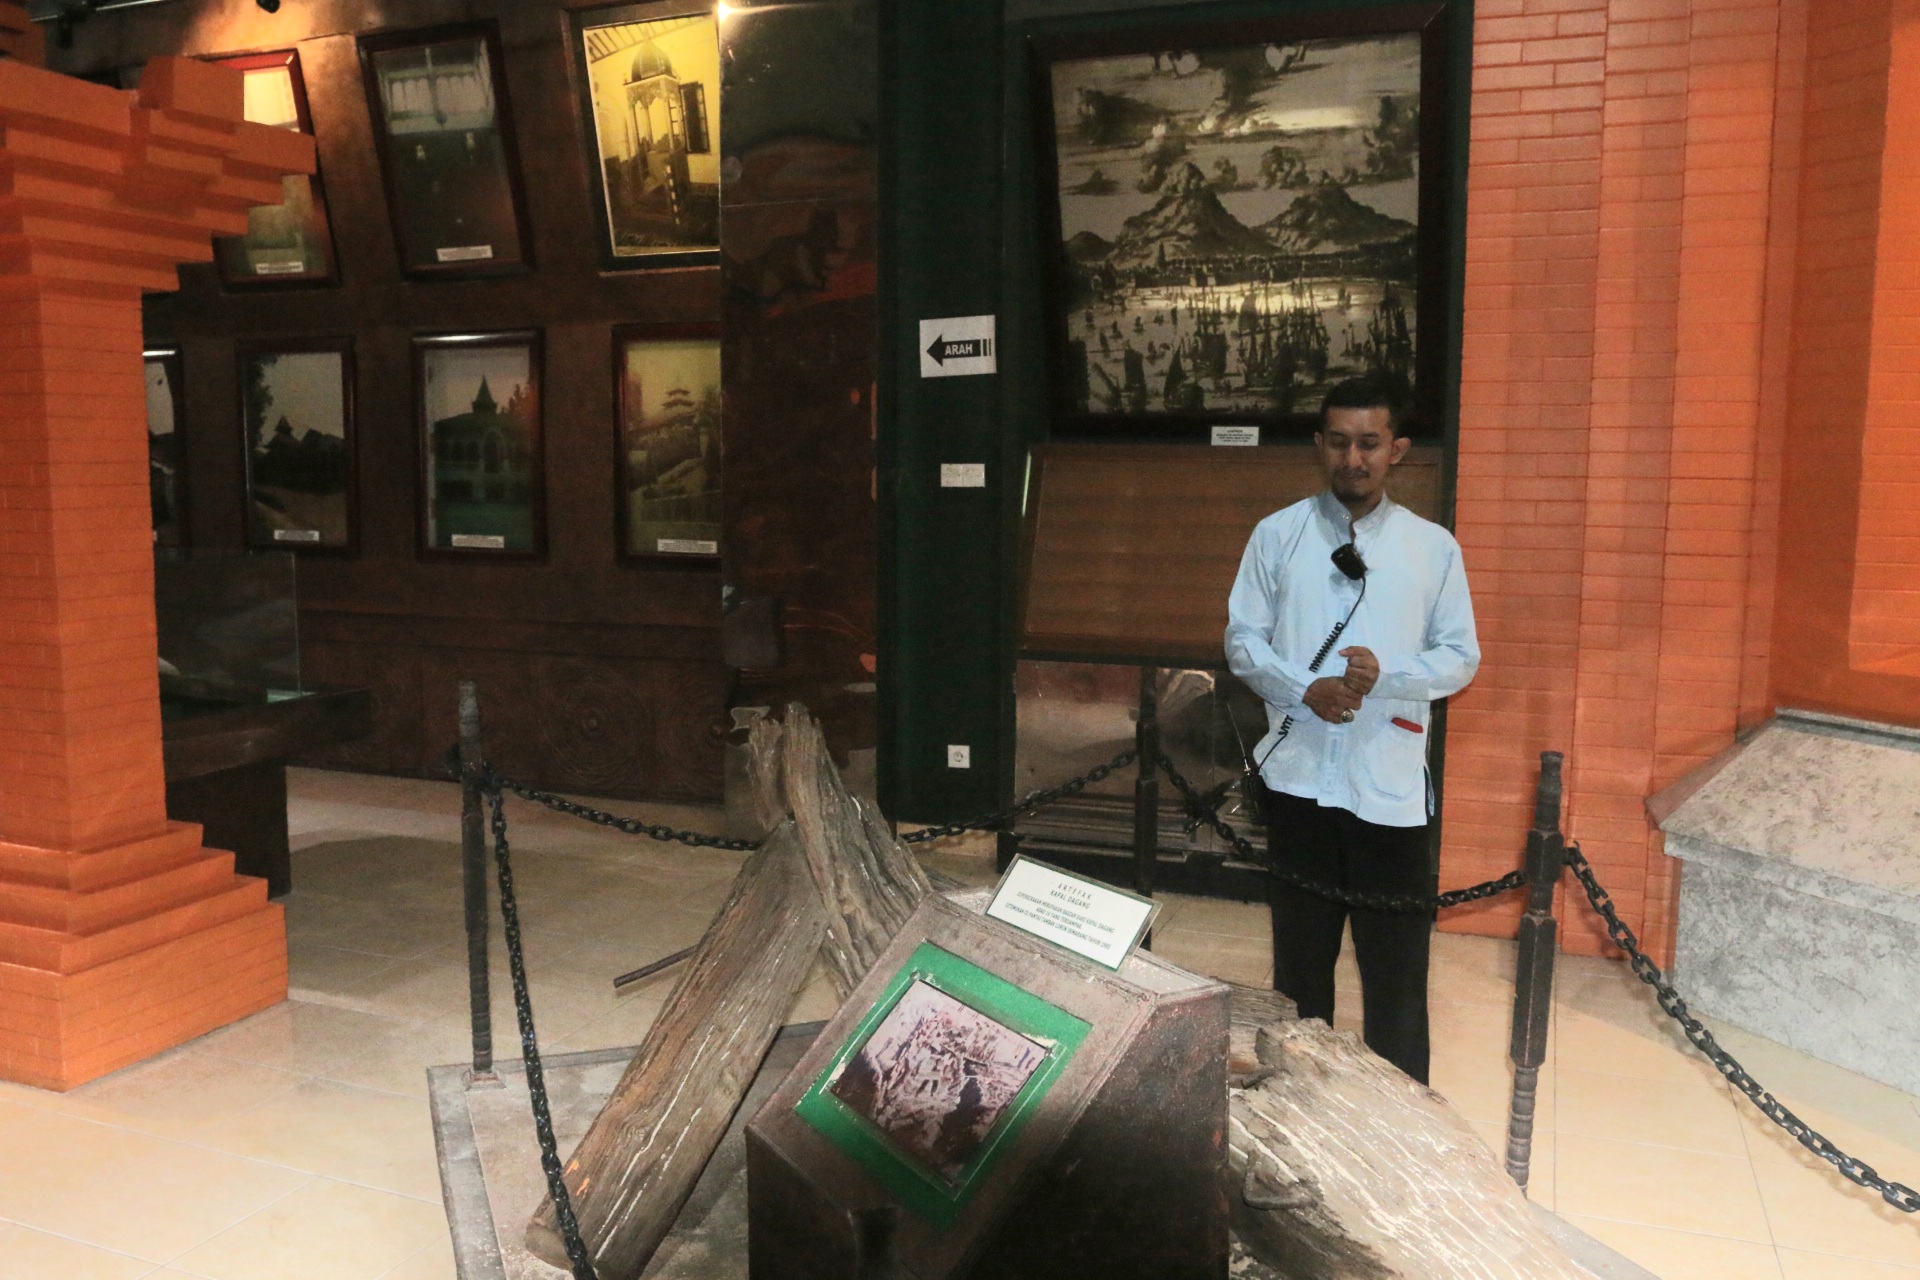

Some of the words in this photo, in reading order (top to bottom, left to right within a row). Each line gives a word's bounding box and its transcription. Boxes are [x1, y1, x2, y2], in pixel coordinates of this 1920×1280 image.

[944, 343, 973, 356] ARAH
[1050, 890, 1067, 900] KAPAL
[1067, 896, 1091, 909] DAGANG
[1058, 883, 1093, 900] ARTEFAK
